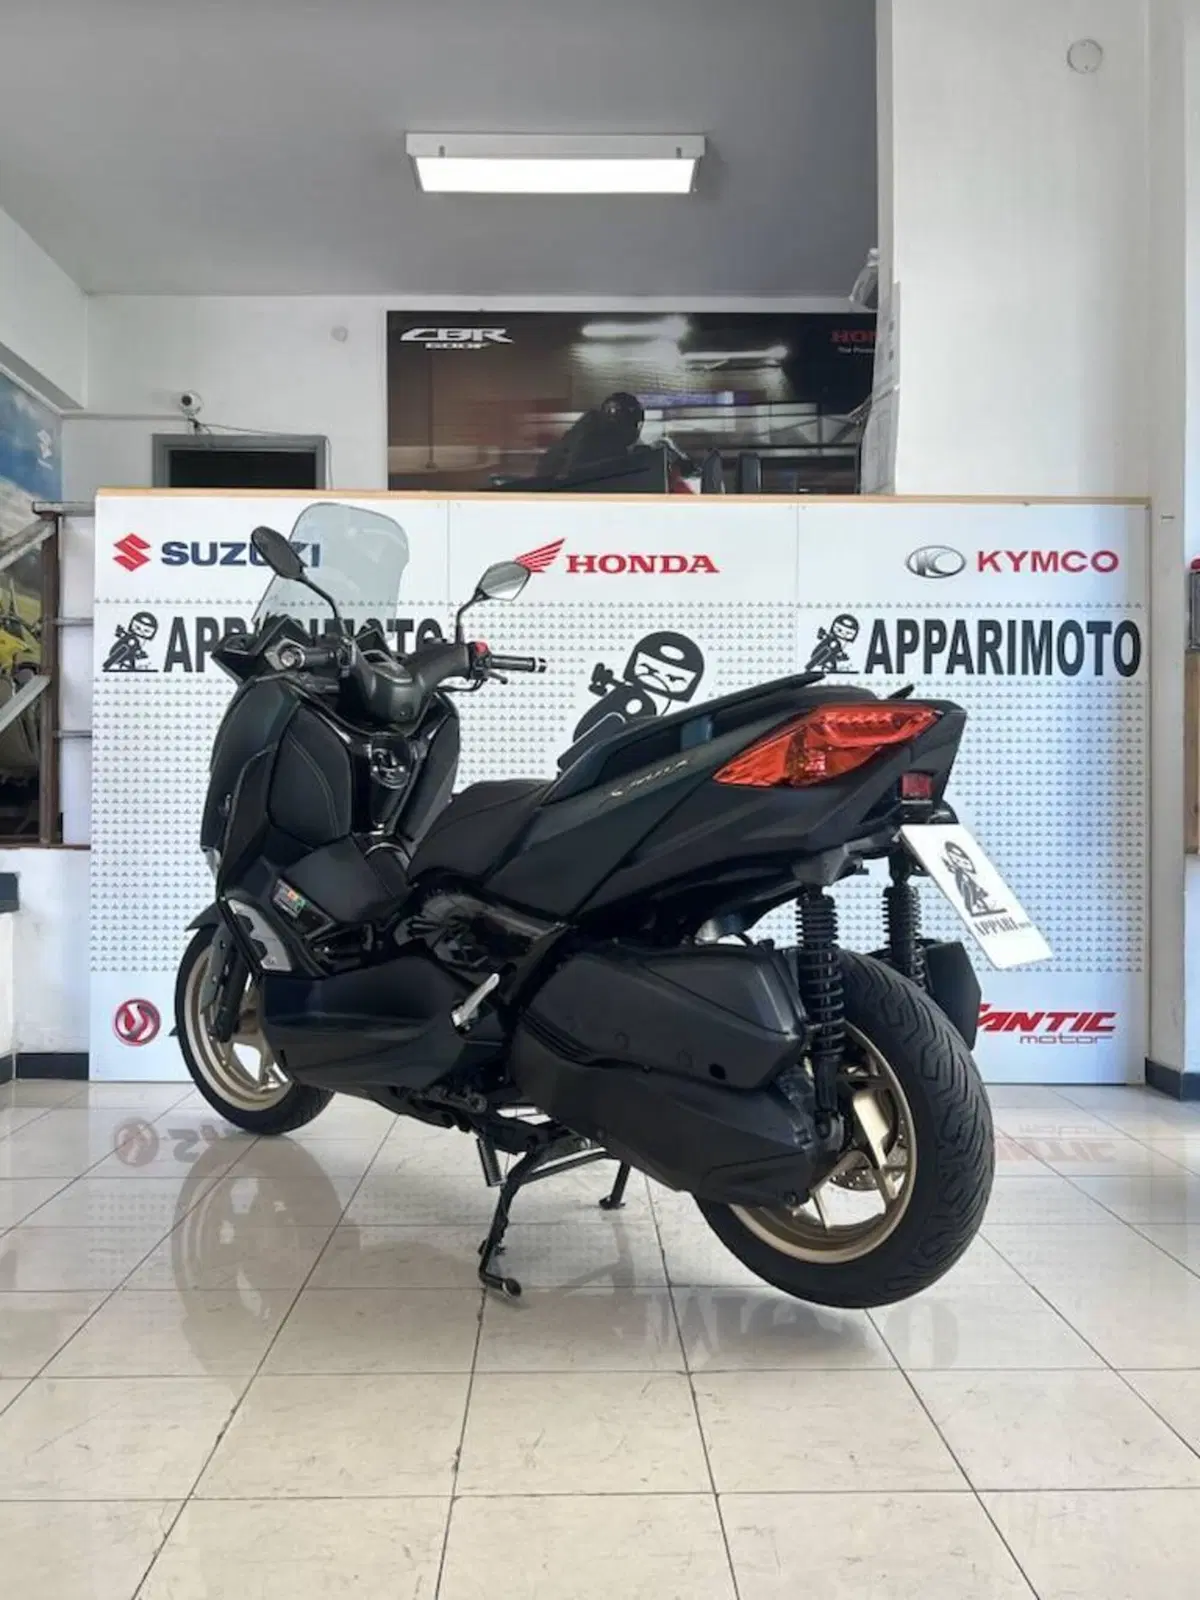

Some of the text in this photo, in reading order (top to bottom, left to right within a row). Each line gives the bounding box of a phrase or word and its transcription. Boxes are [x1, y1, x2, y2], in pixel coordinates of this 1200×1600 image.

[400, 327, 514, 343] CBR
[567, 554, 719, 574] HONDA
[977, 550, 1119, 574] KYMCO
[865, 618, 1142, 676] APPARIMOTO
[1020, 1034, 1113, 1045] motor
